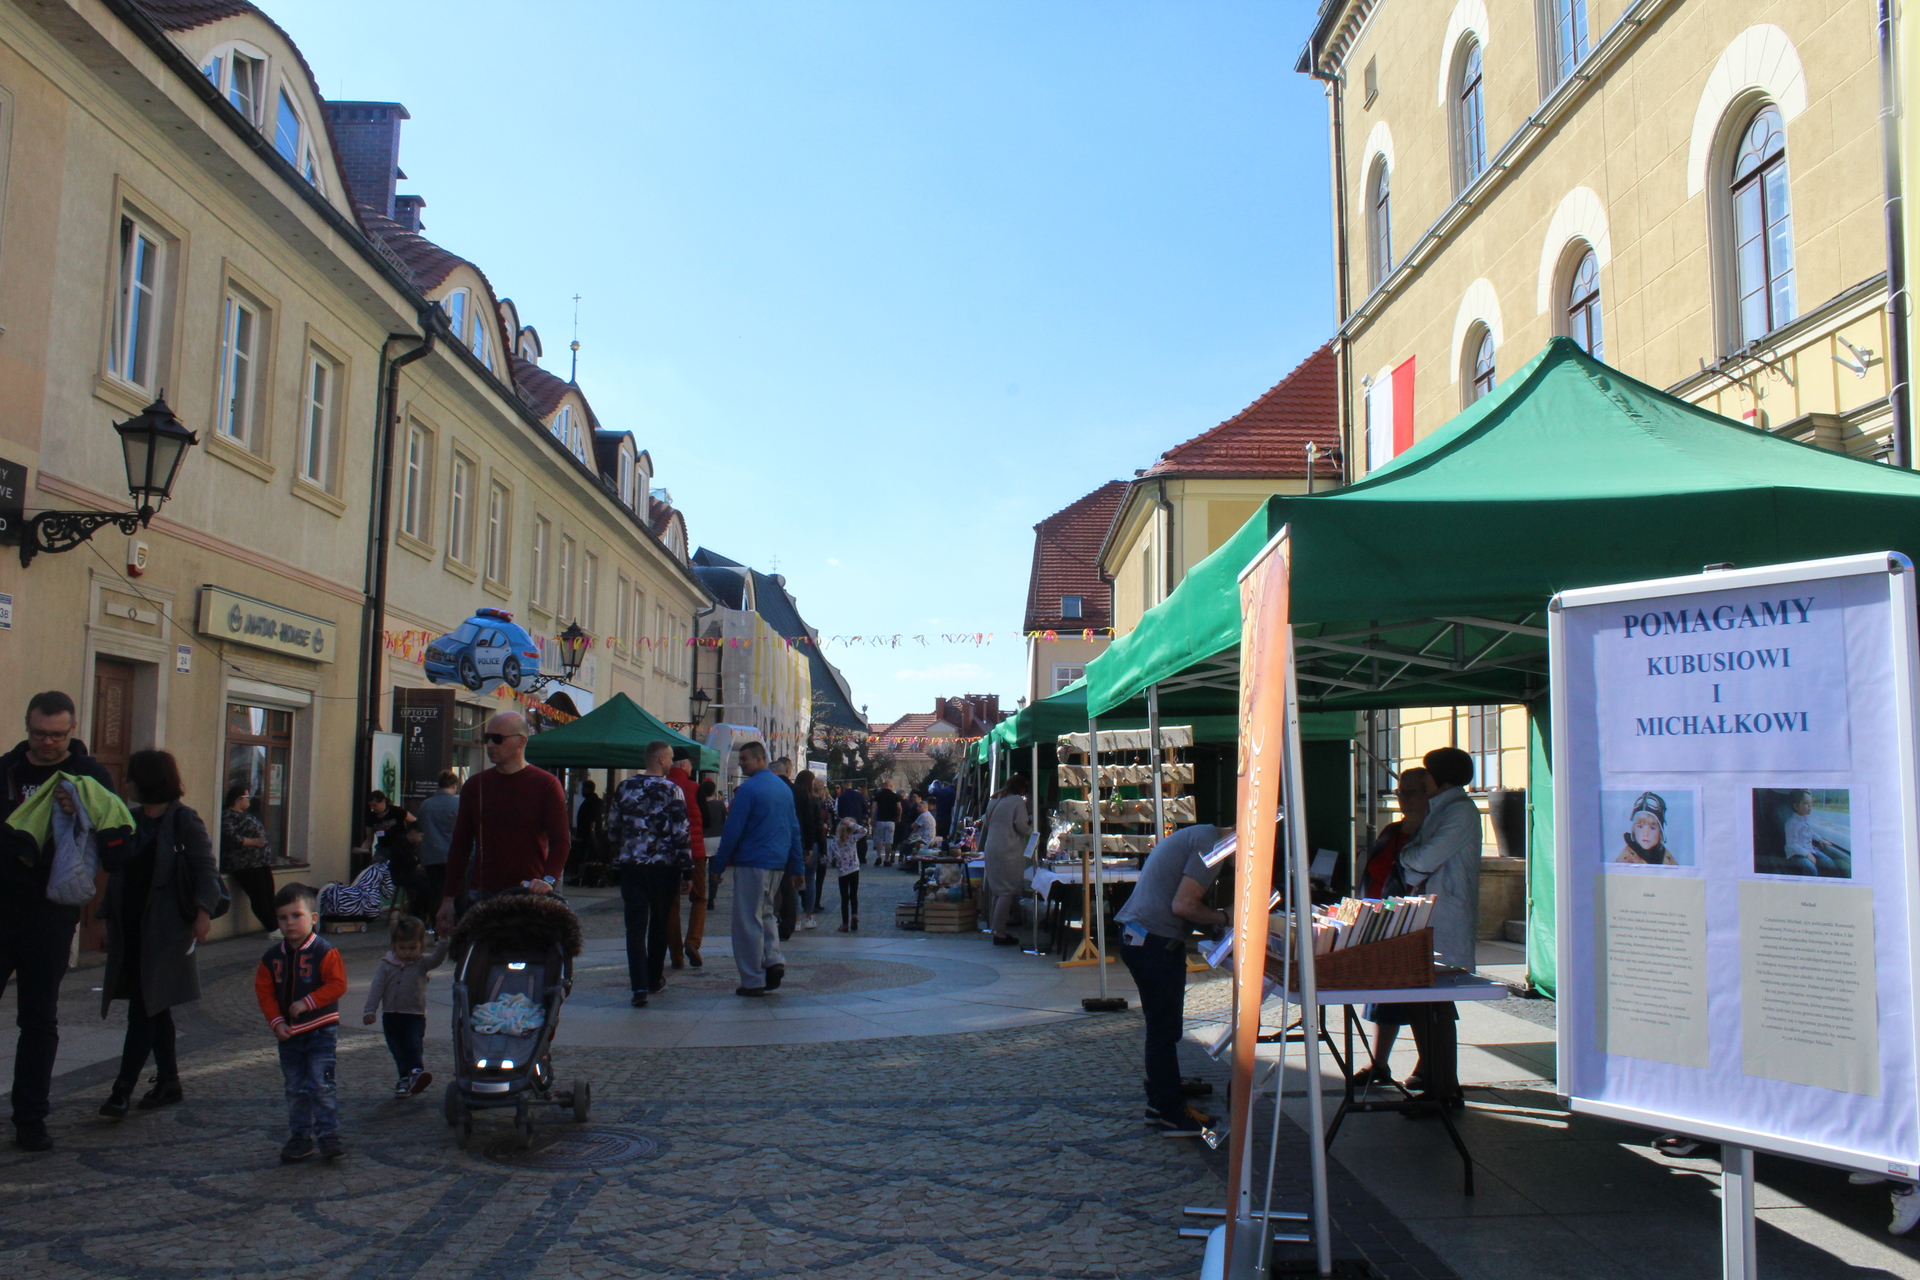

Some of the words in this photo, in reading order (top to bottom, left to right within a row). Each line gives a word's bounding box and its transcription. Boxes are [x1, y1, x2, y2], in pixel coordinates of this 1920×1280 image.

[1622, 597, 1815, 639] POMAGAMY
[477, 657, 500, 665] POLICE
[1646, 647, 1791, 676] KUBUSIOWI
[1711, 683, 1721, 703] I
[414, 726, 422, 736] P
[1635, 711, 1810, 736] MICHAŁKOWI
[300, 955, 312, 976] 5
